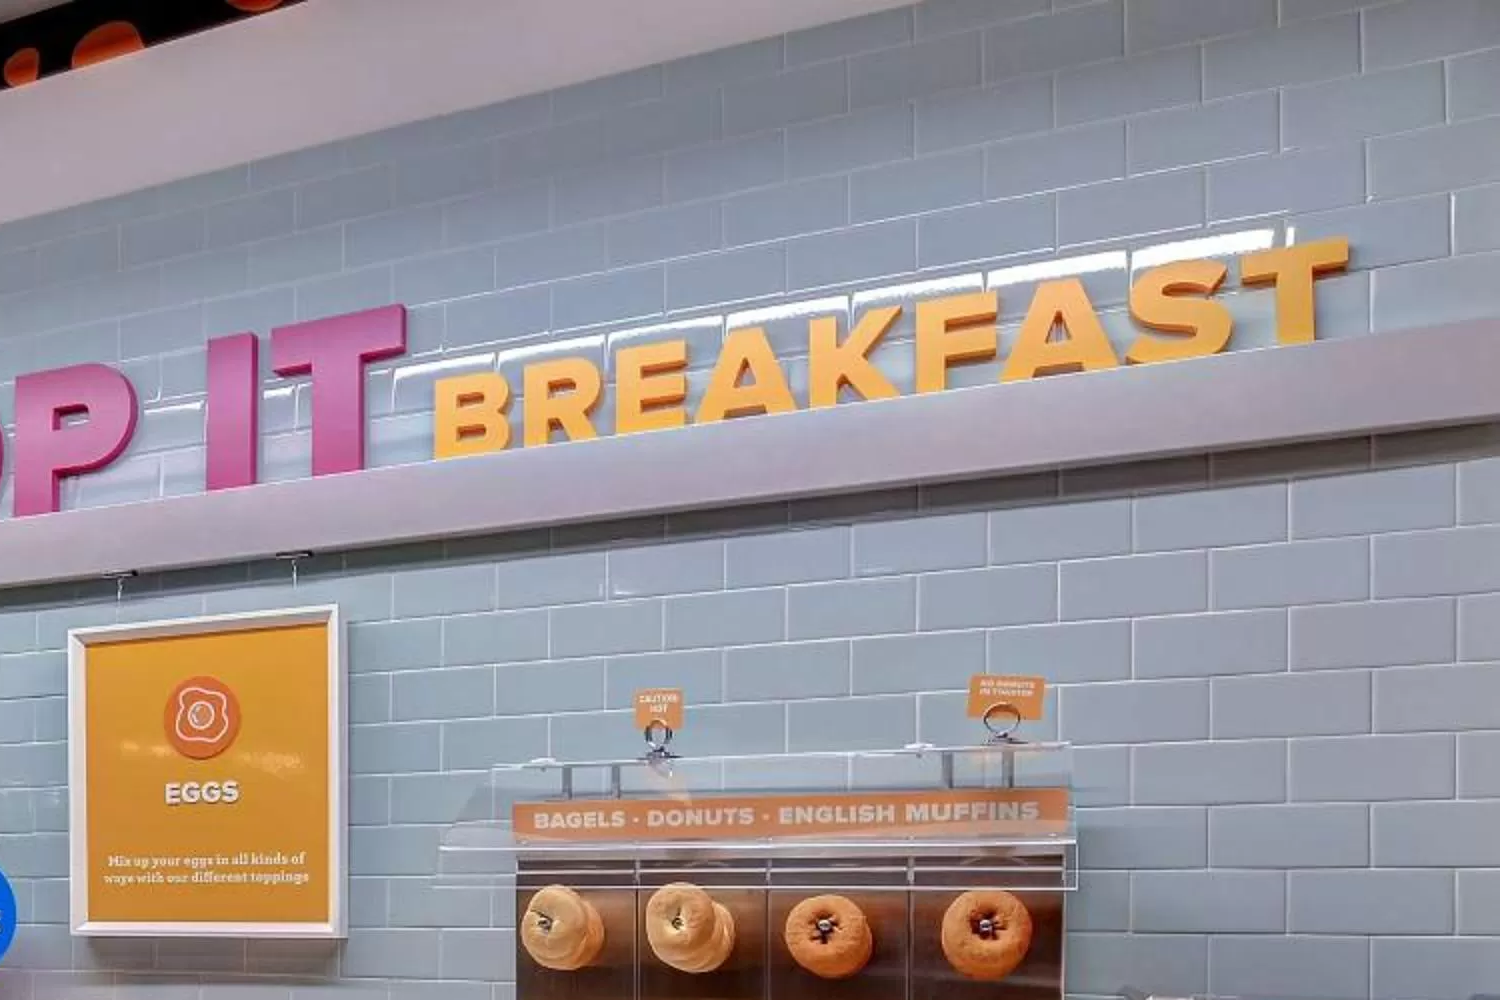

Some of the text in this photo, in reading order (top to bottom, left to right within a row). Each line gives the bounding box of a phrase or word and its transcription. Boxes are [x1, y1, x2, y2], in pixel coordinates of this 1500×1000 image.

[206, 303, 406, 491] IT
[433, 236, 1350, 461] BREAKFAST
[164, 780, 240, 805] EGGS
[534, 800, 1039, 830] BAGELS DONUTS ENGLISH MUFFINS
[107, 851, 306, 869] Mix up your eggs in all kinds of
[104, 871, 309, 886] ways with our different toppings
